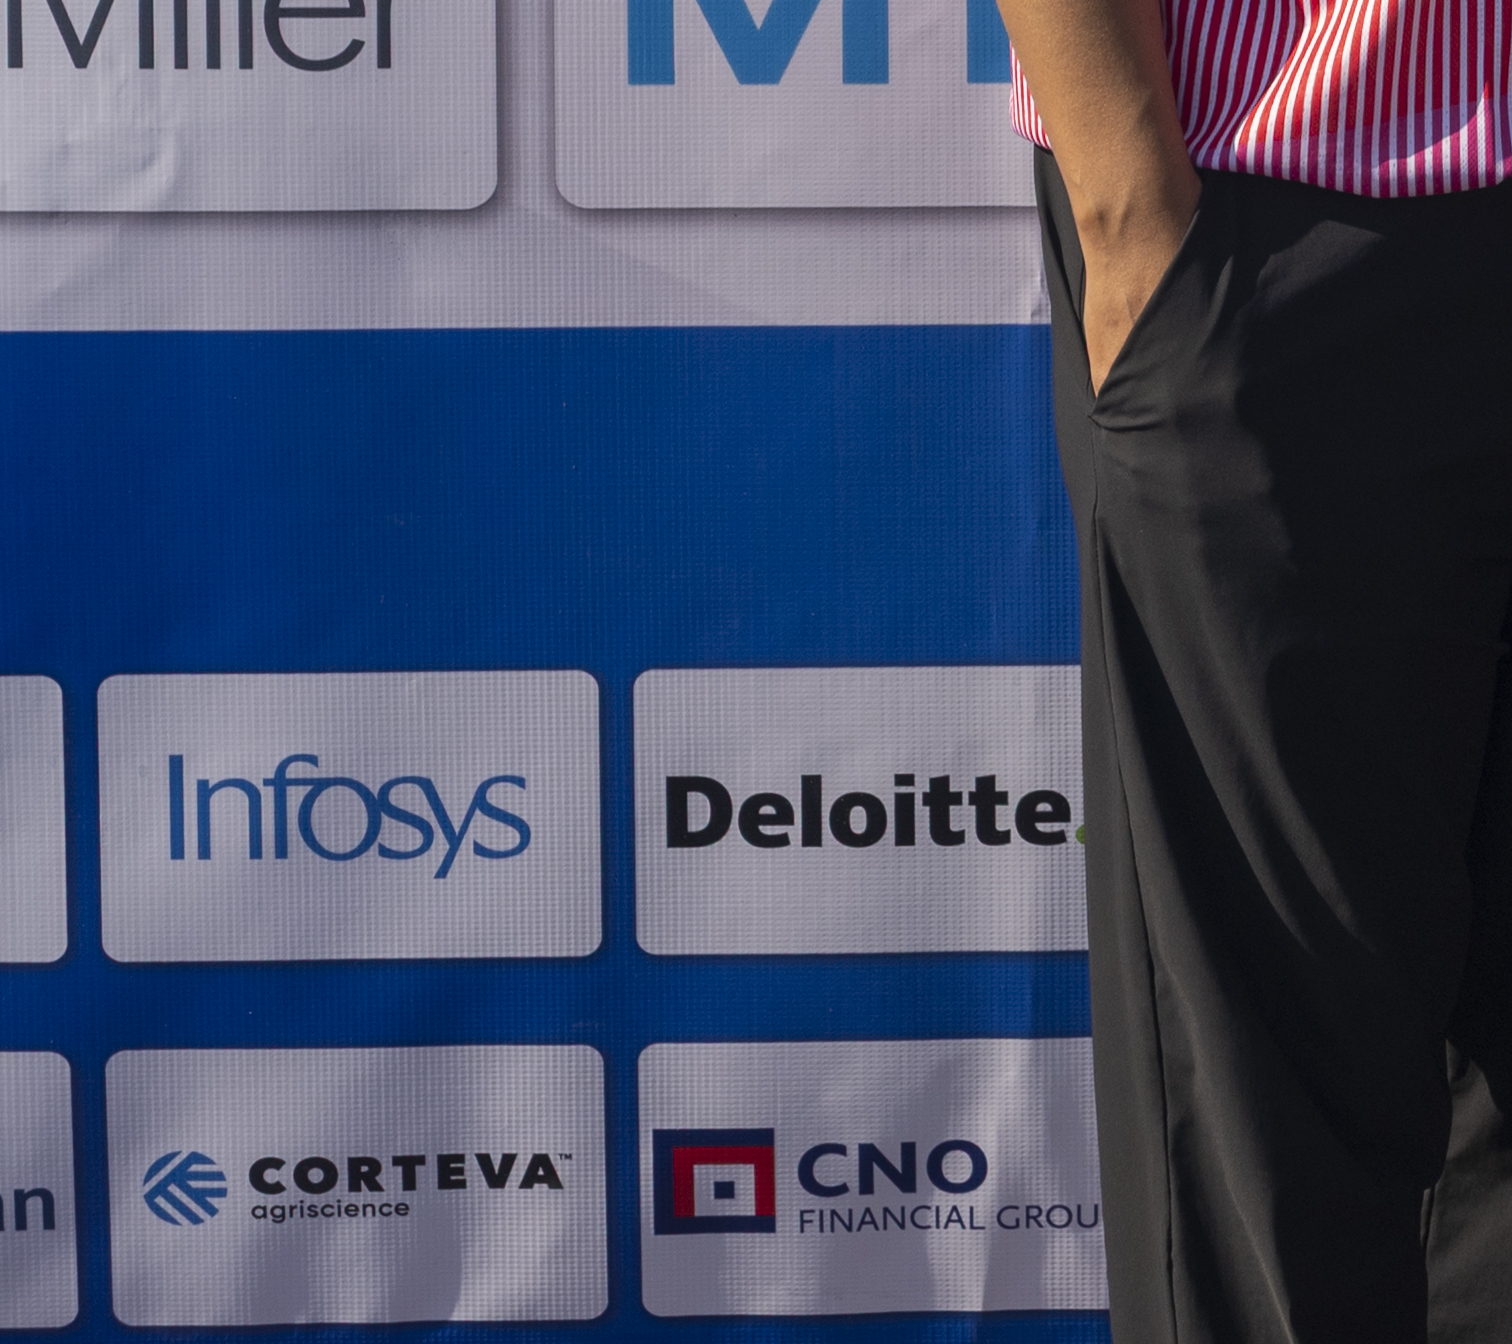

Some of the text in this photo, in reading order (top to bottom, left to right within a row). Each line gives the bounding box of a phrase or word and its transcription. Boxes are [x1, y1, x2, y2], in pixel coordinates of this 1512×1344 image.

[168, 753, 532, 879] Infosys
[798, 1139, 989, 1197] CNO
[250, 1198, 410, 1224] agriscience
[800, 1201, 986, 1234] FINANCIAL
